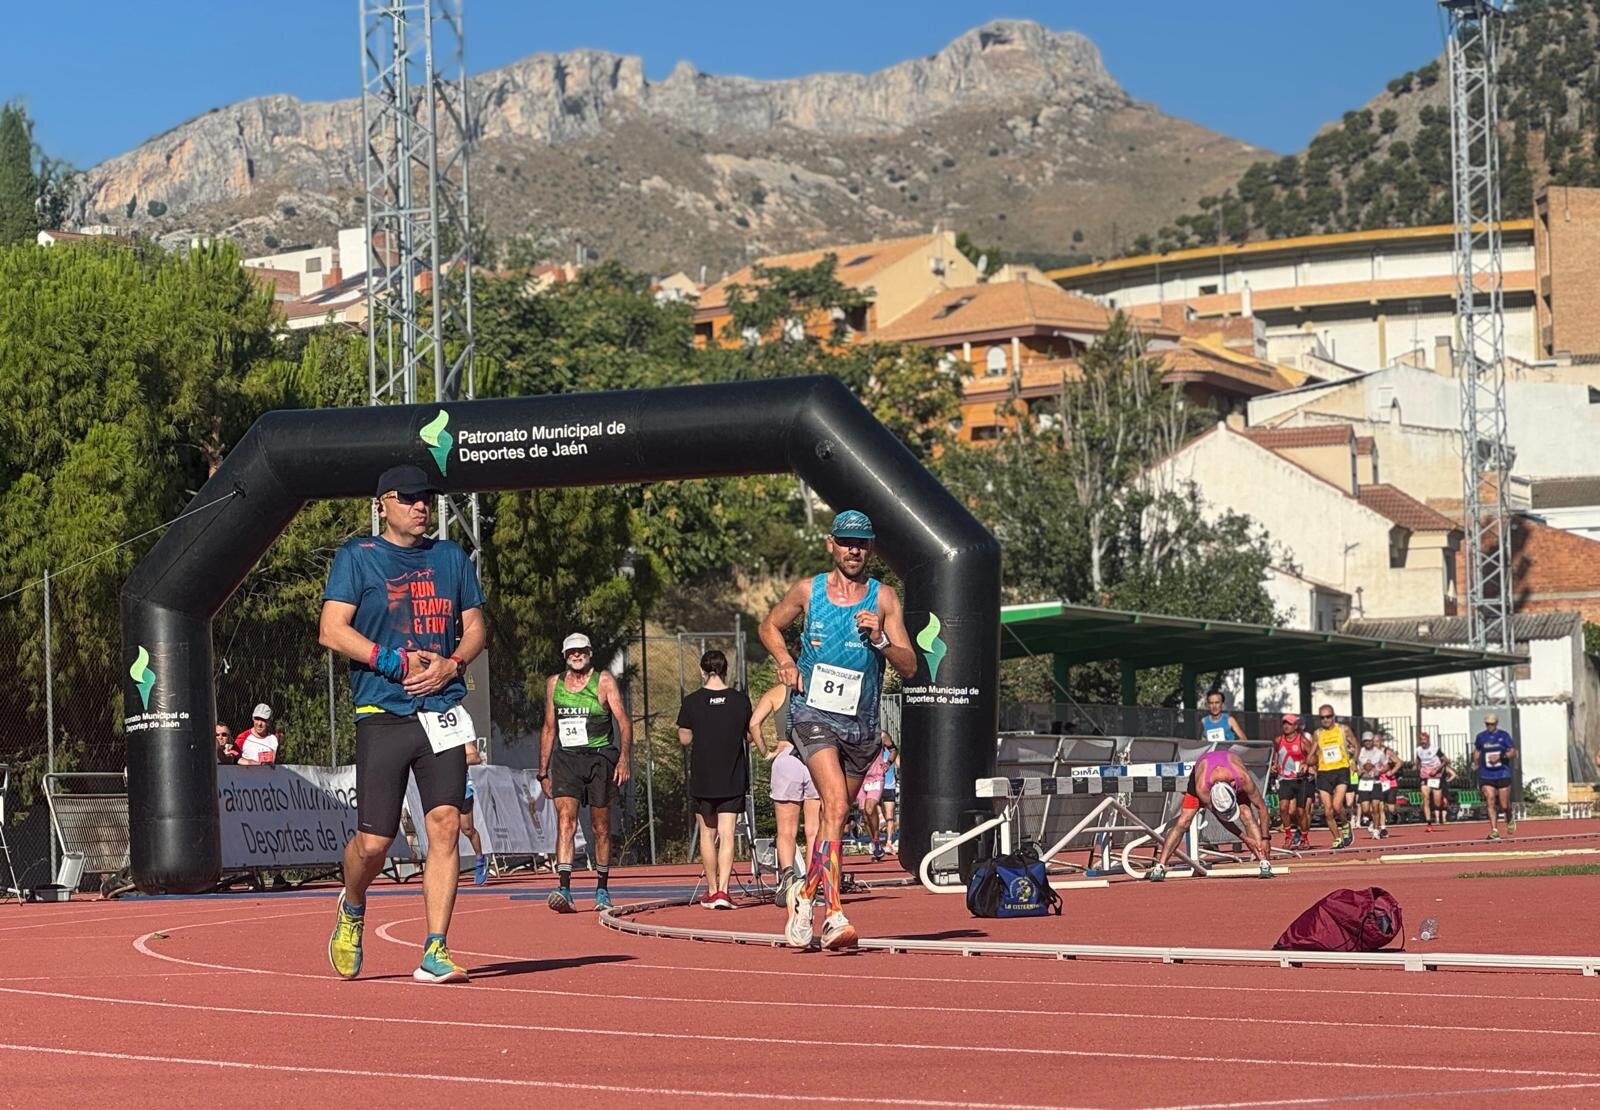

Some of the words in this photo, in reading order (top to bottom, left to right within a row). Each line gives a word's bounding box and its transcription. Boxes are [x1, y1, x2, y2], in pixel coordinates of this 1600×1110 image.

[458, 429, 528, 445] Patronato
[532, 422, 603, 440] Municipal
[607, 421, 626, 435] de
[459, 446, 526, 463] Deportes
[529, 444, 548, 458] de
[552, 441, 588, 457] Jaén
[410, 581, 436, 598] RUN
[823, 680, 844, 696] 81
[928, 685, 968, 696] Municipal
[969, 687, 979, 695] de
[936, 695, 947, 703] de
[949, 696, 969, 704] Jaén
[142, 711, 178, 720] Municipal
[179, 711, 190, 719] de
[557, 707, 590, 715] XXXIII
[149, 720, 159, 728] de
[160, 720, 180, 728] Jaén
[437, 712, 457, 728] 59
[565, 727, 577, 736] 34
[219, 781, 289, 813] atronato
[288, 779, 358, 818] Municipa
[241, 822, 314, 860] Deportes
[316, 820, 338, 851] de
